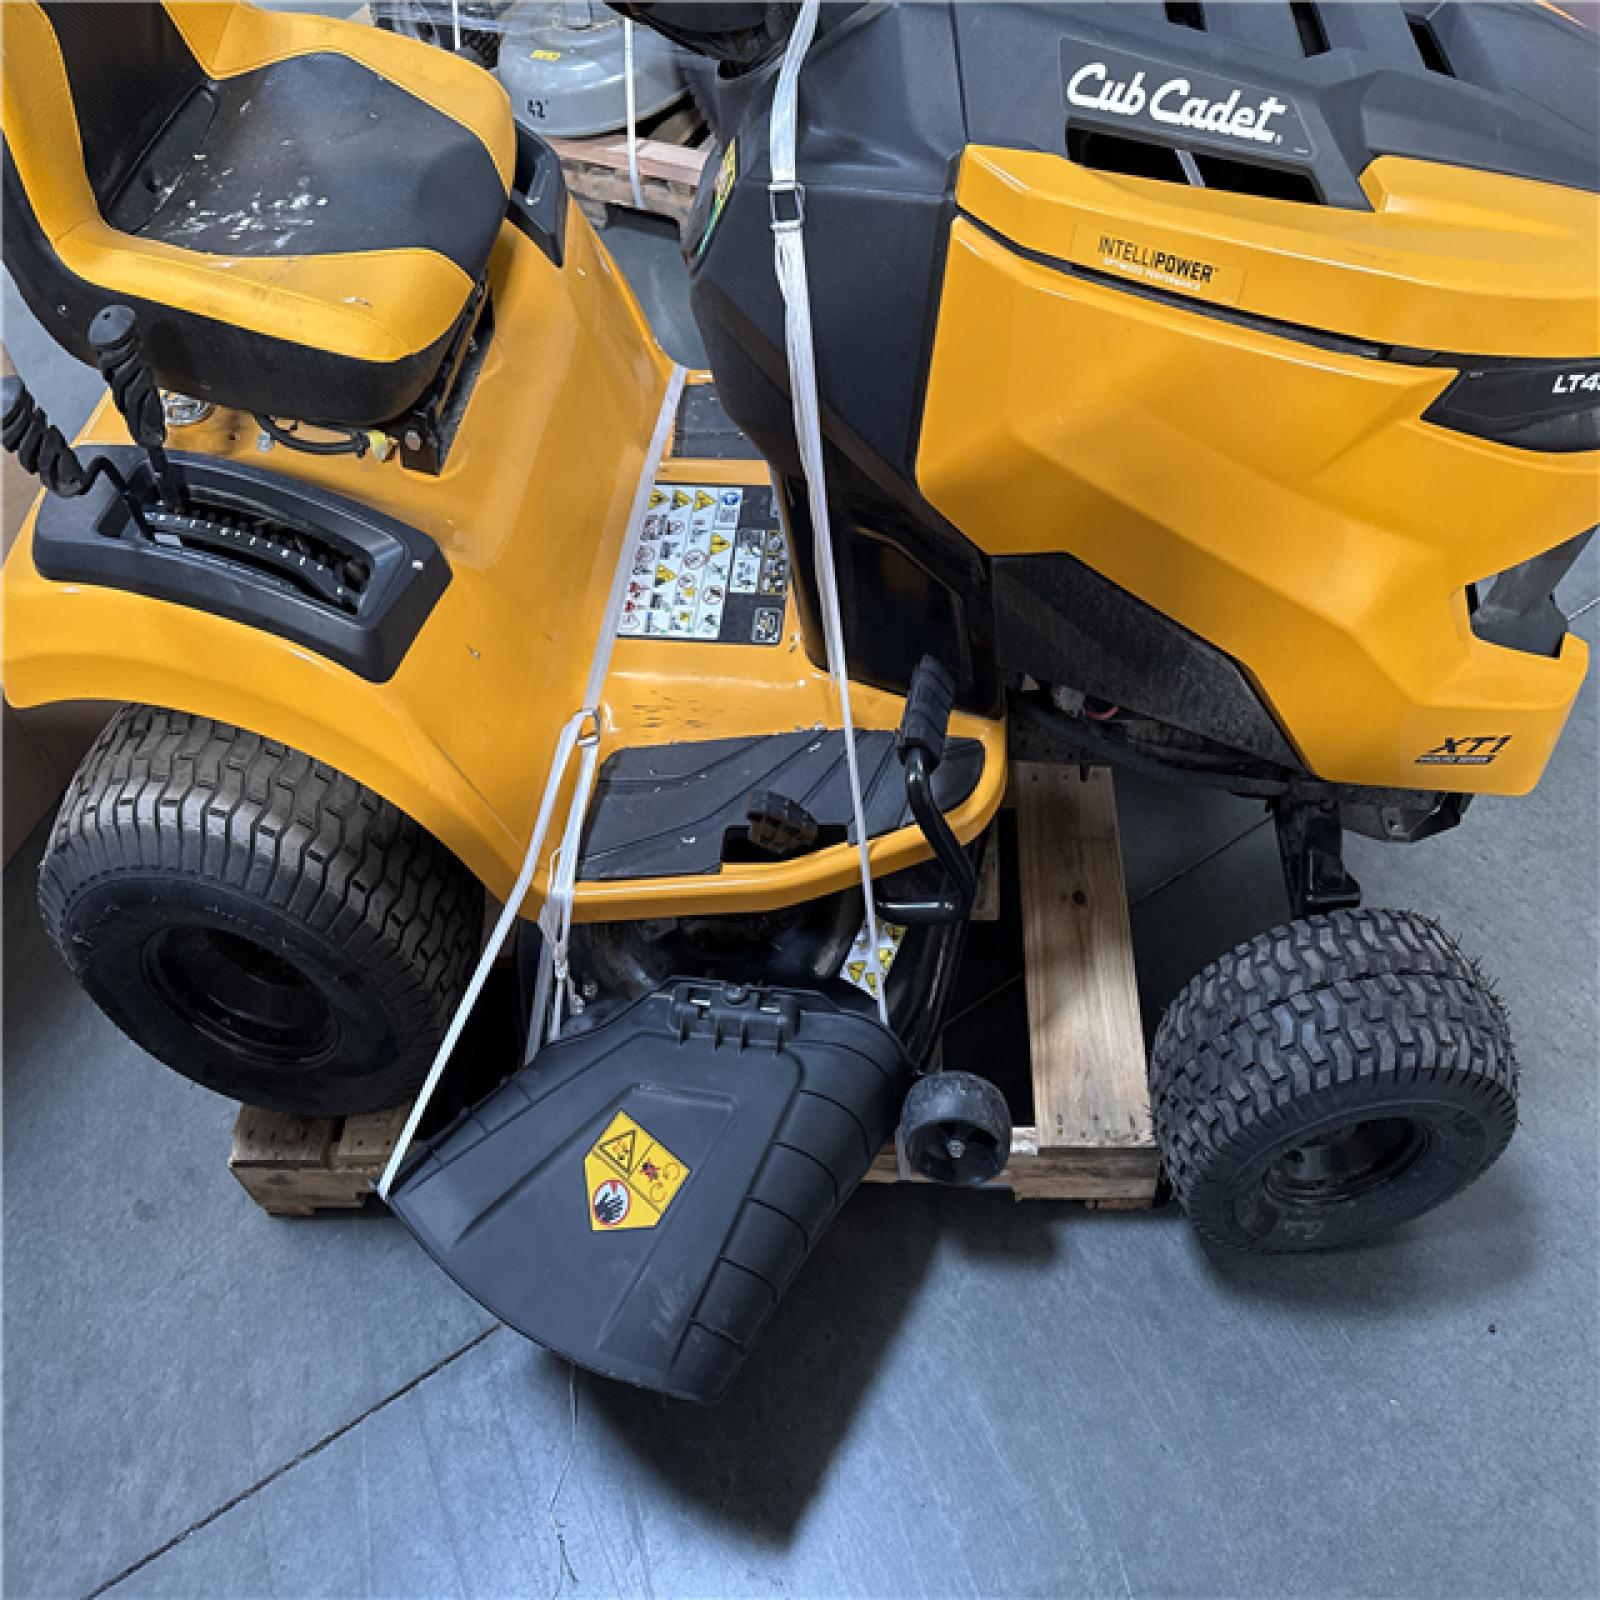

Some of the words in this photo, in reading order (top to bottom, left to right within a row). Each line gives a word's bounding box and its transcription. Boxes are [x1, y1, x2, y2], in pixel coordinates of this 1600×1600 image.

[1067, 62, 1146, 116] Cub
[1149, 77, 1287, 144] Cadet
[1098, 234, 1213, 283] INTELLIPOWER
